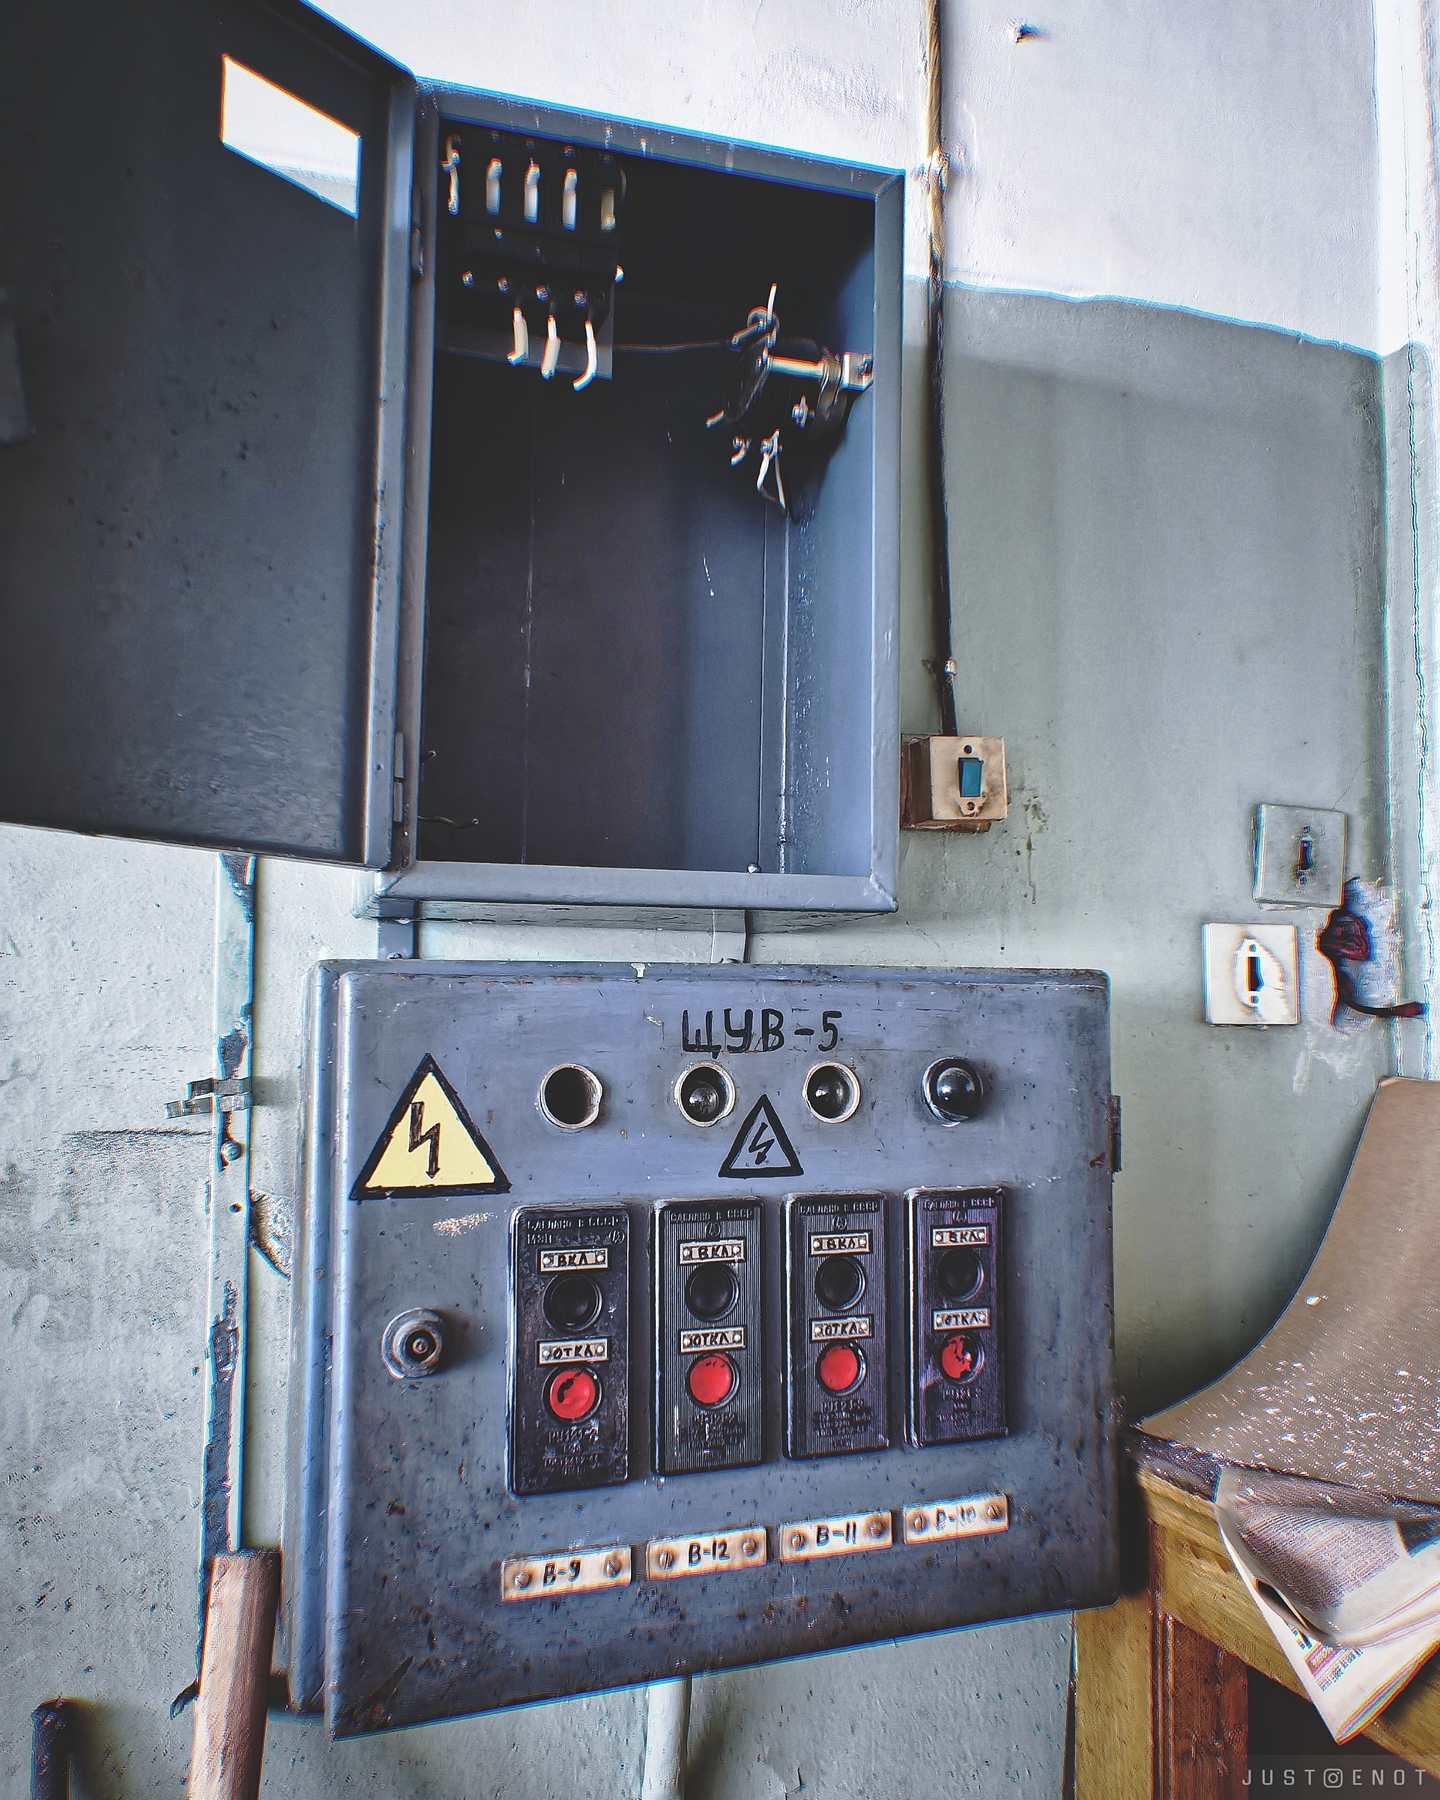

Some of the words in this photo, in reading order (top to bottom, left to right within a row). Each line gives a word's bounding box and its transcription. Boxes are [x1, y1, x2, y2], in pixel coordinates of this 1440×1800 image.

[682, 1008, 842, 1059] ЩУВ-5
[697, 1243, 730, 1259] ВКЛ
[826, 1236, 858, 1250] ВКЛ
[556, 1251, 591, 1267] ВКЛ
[944, 1311, 980, 1327] ОТКЛ
[824, 1320, 859, 1336] ОТКЛ
[693, 1331, 730, 1347] ОТКЛ
[553, 1343, 594, 1360] ОТКЛ
[816, 1521, 858, 1548] В-11
[687, 1537, 731, 1568] В-12
[542, 1560, 582, 1588] В-9
